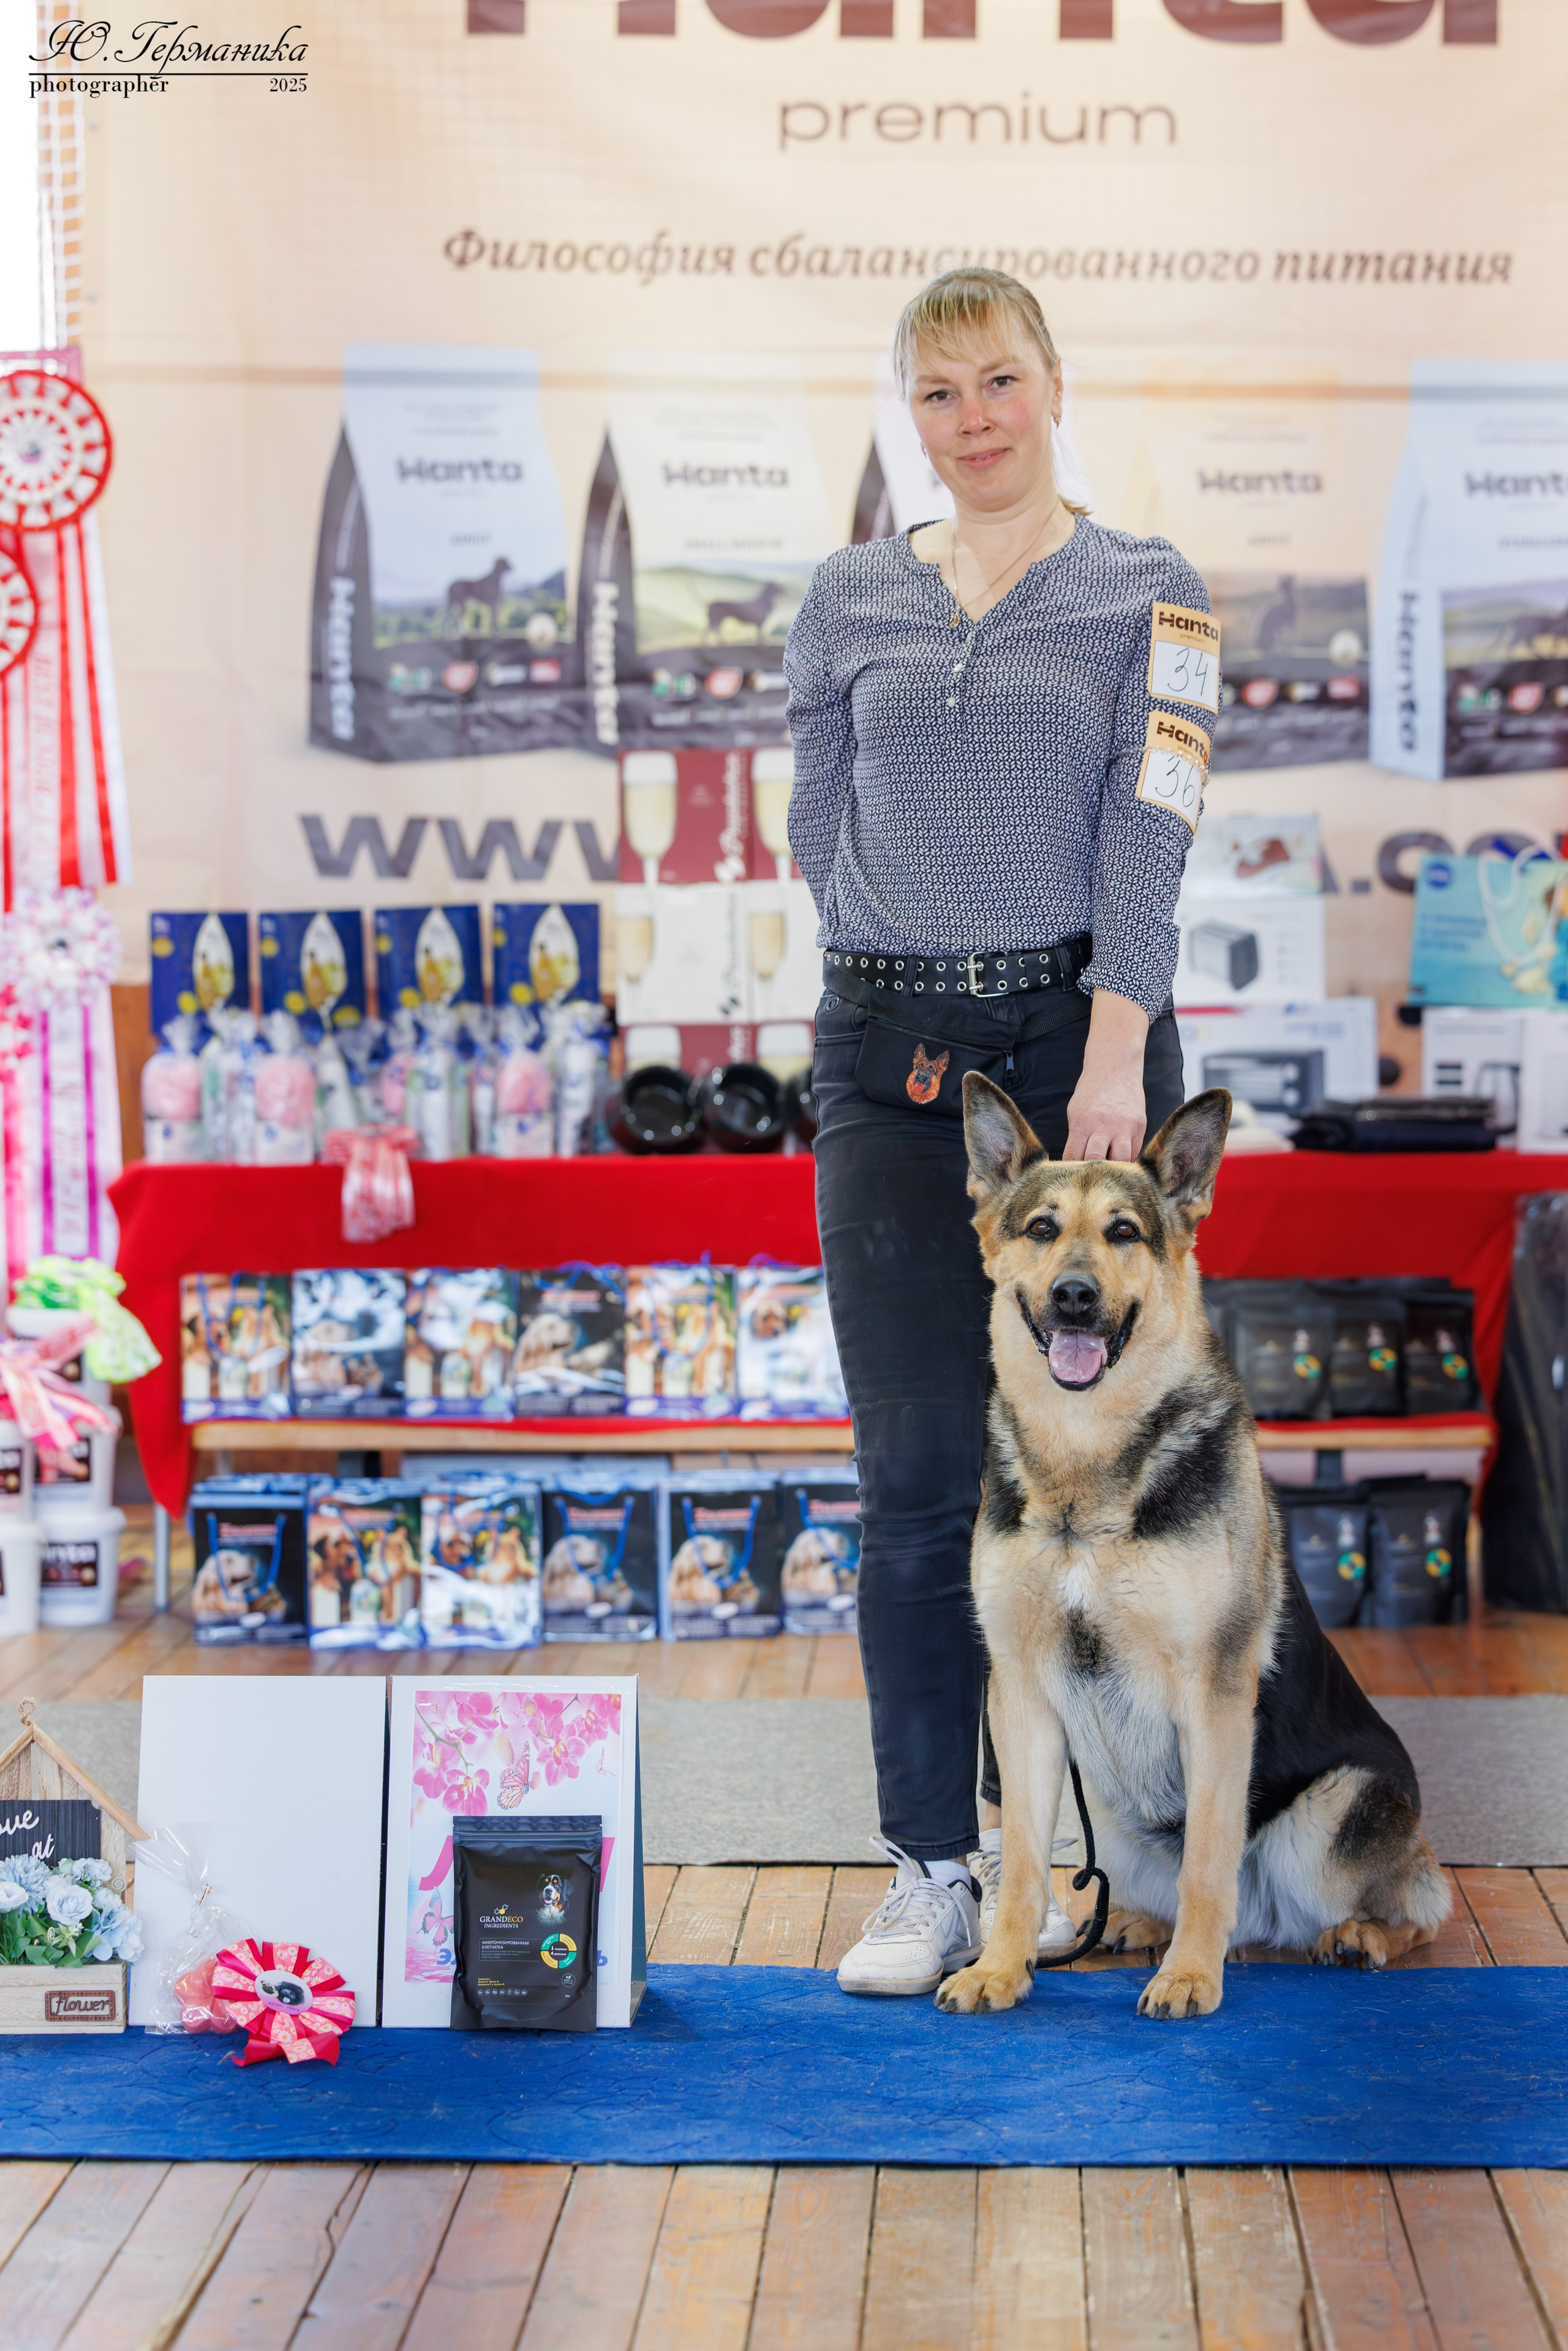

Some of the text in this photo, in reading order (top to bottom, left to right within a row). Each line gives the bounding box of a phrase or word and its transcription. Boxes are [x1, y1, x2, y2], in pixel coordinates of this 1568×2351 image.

[779, 90, 1176, 151] premium
[442, 229, 735, 287] Философия
[1273, 249, 1513, 284] питания
[397, 458, 523, 484] Hanta
[662, 462, 789, 488] Hanta
[1197, 470, 1323, 494] Hanta
[1464, 471, 1568, 498] Hant
[1158, 611, 1219, 642] Hanta
[1179, 632, 1205, 644] premium
[1167, 647, 1208, 696] 34
[1155, 755, 1195, 807] 36
[32, 1833, 56, 1860] at
[53, 1996, 110, 2015] flower
